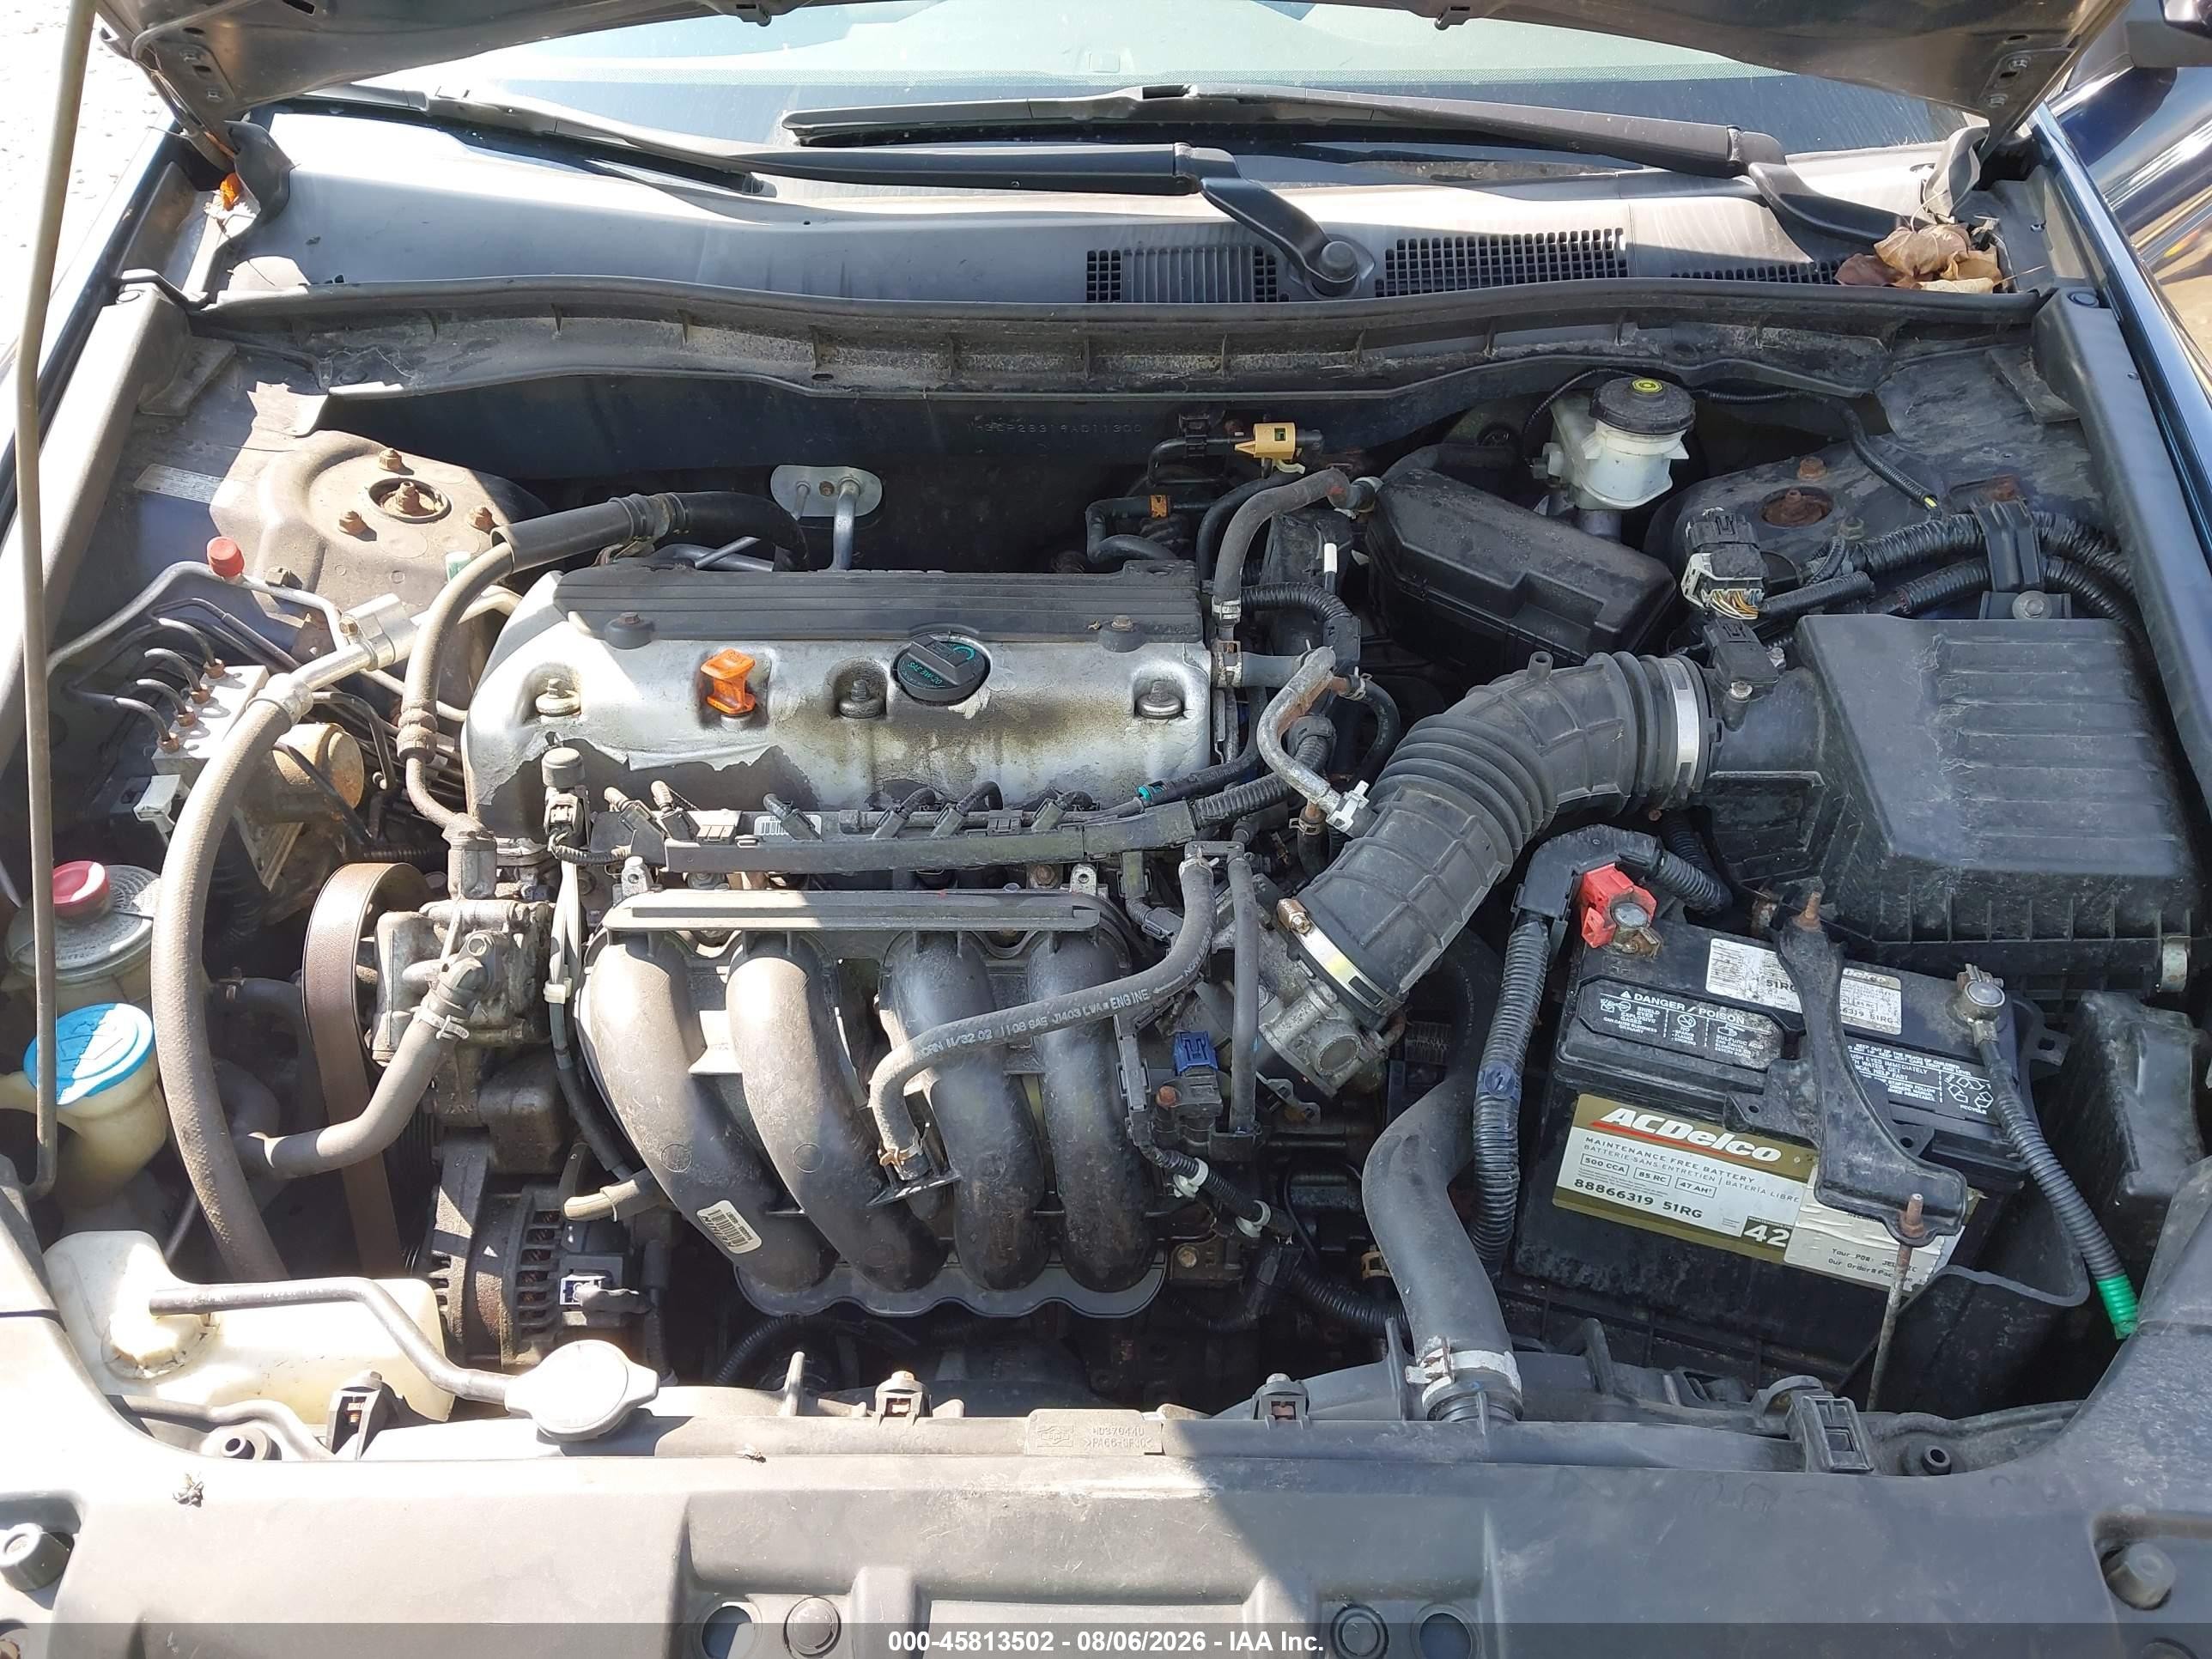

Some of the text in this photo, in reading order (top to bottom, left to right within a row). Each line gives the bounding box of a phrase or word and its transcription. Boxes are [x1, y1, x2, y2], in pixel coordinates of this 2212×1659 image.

[907, 661, 923, 672] SAE
[920, 670, 943, 684] 5W-20
[1029, 1016, 1048, 1030] SAE
[1109, 988, 1151, 1011] ENGINE
[1634, 993, 1686, 1012] DANGER
[1698, 1007, 1746, 1024] POISON
[1637, 1006, 1661, 1016] SHIELD
[1637, 1011, 1654, 1019] EYES
[1620, 1012, 1656, 1024] EXPLOSIVE
[1620, 1016, 1643, 1025] GASES
[1716, 1034, 1765, 1049] SULFURIC ACID
[1867, 1056, 1882, 1065] EYES
[1884, 1060, 1928, 1075] IMMEDIATELY
[1905, 1052, 1923, 1060] REACH
[1933, 1059, 1960, 1069] CHILDREN
[1874, 1068, 1891, 1077] HELP
[1892, 1072, 1909, 1080] FAST
[1599, 1108, 1782, 1162] ACDelco
[1583, 1145, 1630, 1161] BATTERIE
[1634, 1158, 1658, 1168] SANS
[1662, 1164, 1716, 1182] ENTRETIEN
[1585, 1137, 1755, 1183] MAINTENANCE FREE BATTERY
[1585, 1157, 1626, 1173] 500 CCA
[1638, 1170, 1666, 1183] 85 RC
[1679, 1181, 1692, 1189] 47
[1574, 1178, 1654, 1206] 88866319
[1662, 1200, 1704, 1219] 51RG
[1770, 1190, 1801, 1203] LIBRE
[1743, 1224, 1791, 1248] 42
[1832, 1249, 1850, 1258] Your
[1828, 1258, 1843, 1267] Our
